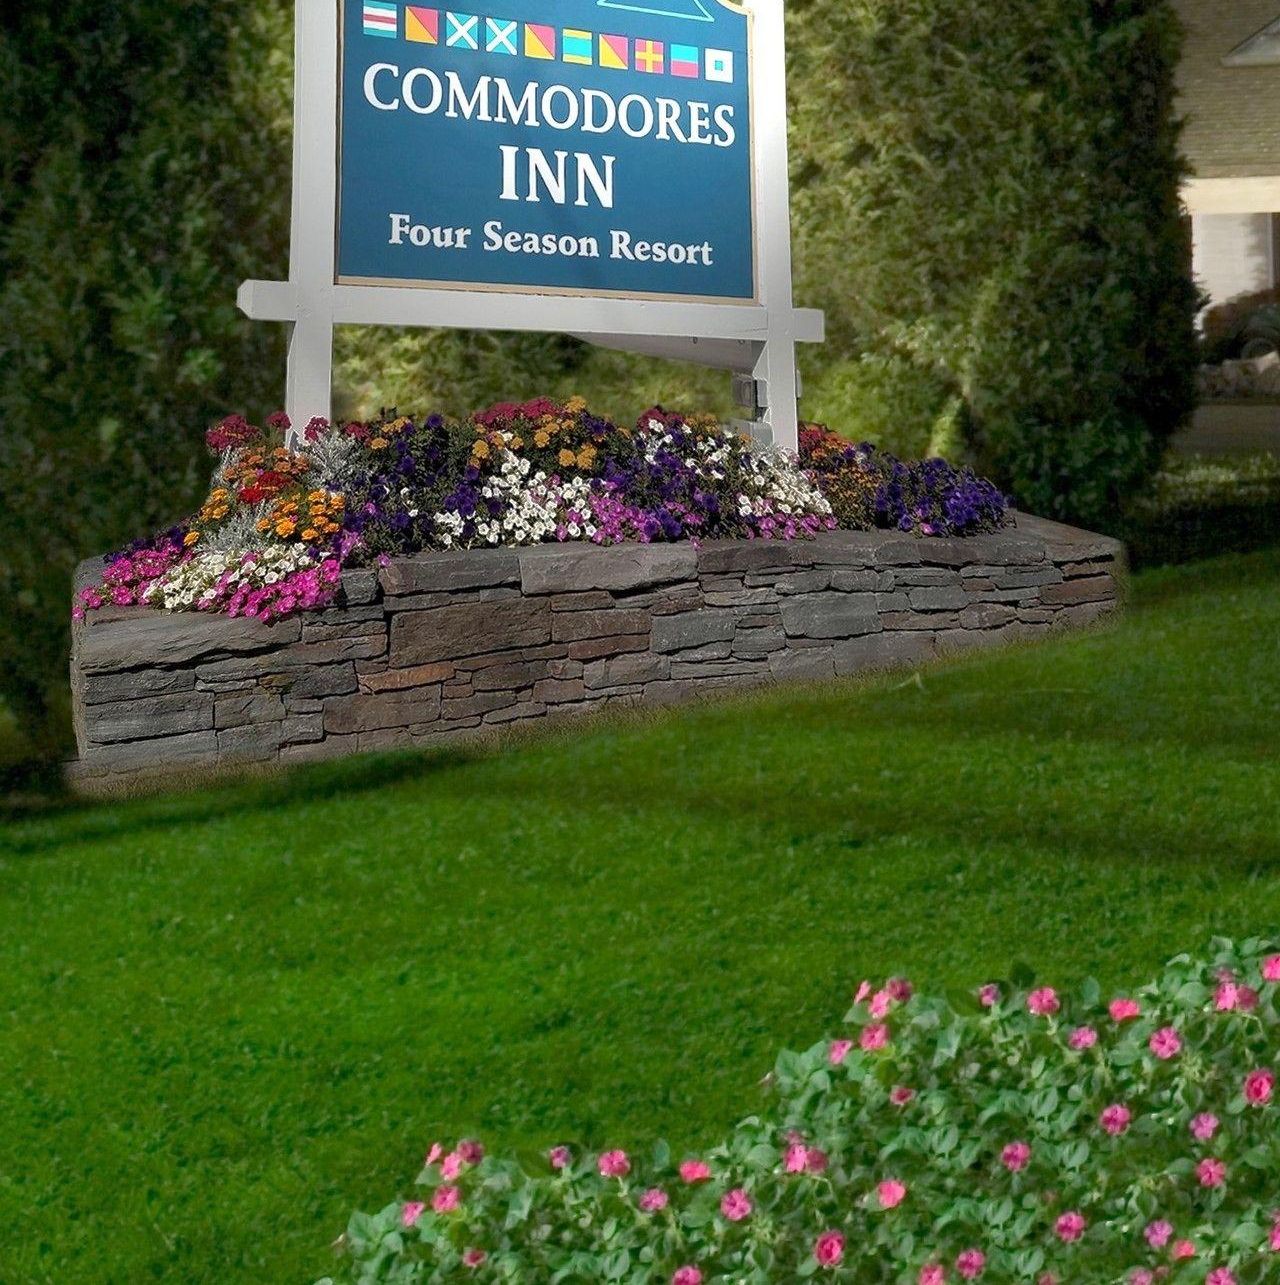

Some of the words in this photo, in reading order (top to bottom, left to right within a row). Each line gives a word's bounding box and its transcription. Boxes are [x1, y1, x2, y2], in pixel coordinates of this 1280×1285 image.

[363, 63, 735, 147] COMMODORES
[500, 144, 616, 208] INN
[388, 213, 470, 249] Four
[482, 221, 600, 257] Season
[610, 229, 713, 266] Resort
